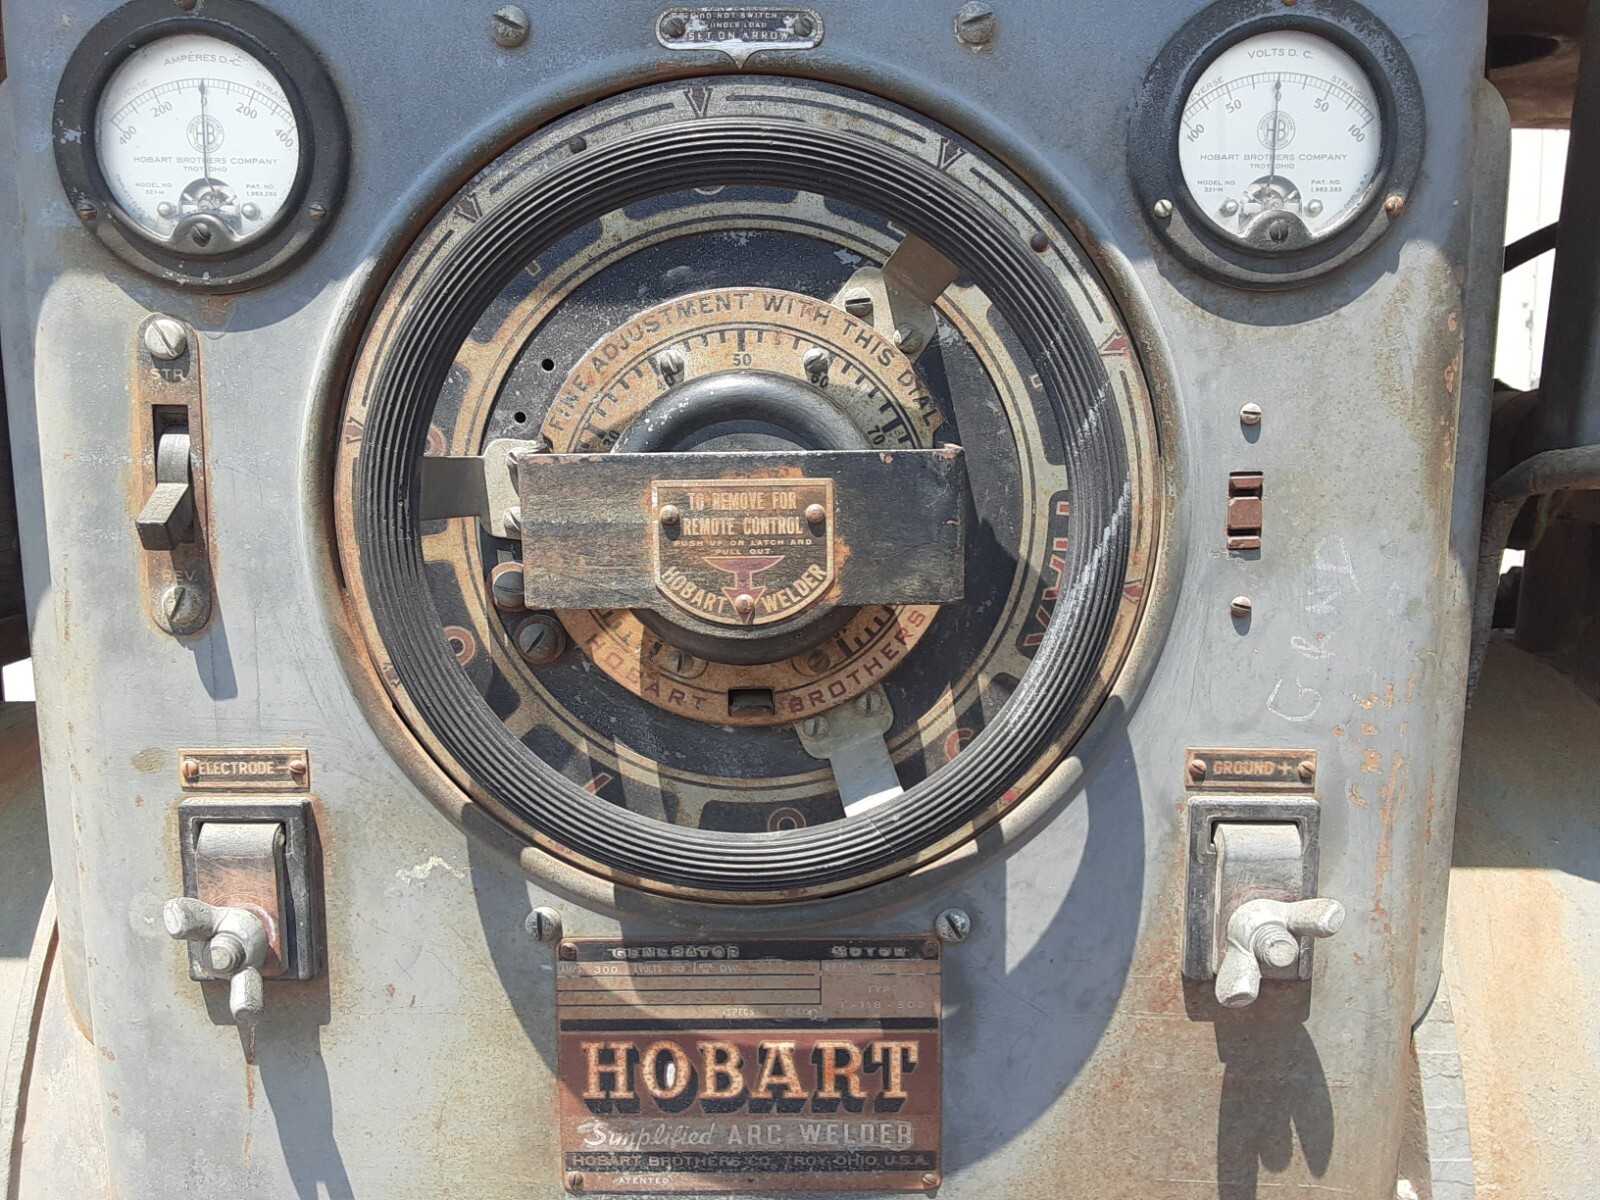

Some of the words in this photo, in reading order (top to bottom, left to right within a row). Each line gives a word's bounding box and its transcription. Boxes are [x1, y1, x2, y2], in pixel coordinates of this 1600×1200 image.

[687, 31, 712, 41] SET
[718, 31, 735, 40] ON
[743, 31, 790, 41] ARROW
[163, 53, 218, 66] AMPERES
[1247, 48, 1285, 60] VOLTS
[118, 125, 137, 146] 400
[150, 101, 173, 118] 200
[235, 102, 258, 120] 200
[274, 127, 294, 148] 400
[1186, 123, 1205, 143] 100
[1225, 98, 1242, 114] 50
[1313, 98, 1330, 113] 50
[1347, 123, 1366, 143] 100
[133, 156, 173, 164] HOBART
[176, 156, 227, 165] BROTHERS
[230, 157, 278, 165] COMPANY
[1200, 153, 1240, 161] HOBART
[1243, 153, 1295, 161] BROTHERS
[1298, 153, 1348, 161] COMPANY
[591, 292, 748, 371] ADJUSTMENT
[761, 292, 832, 328] WITH
[844, 317, 902, 368] THIS
[897, 369, 938, 426] DIAL
[733, 353, 752, 367] 50
[867, 425, 886, 445] 70
[687, 492, 705, 511] TO
[712, 492, 765, 511] REMOVE
[772, 491, 797, 510] FOR
[682, 517, 736, 536] REMOTE
[743, 516, 803, 535] CONTROL
[790, 538, 812, 546] AND
[661, 565, 729, 614] HOBART
[761, 563, 828, 613] WELDER
[584, 633, 712, 711] HOBART
[787, 610, 926, 714] BROTHERS
[198, 761, 274, 775] ELECTRODE
[1213, 760, 1276, 776] GROUND
[611, 946, 740, 959] GENERATOR
[593, 965, 618, 974] 300
[580, 1040, 920, 1103] HOBART
[580, 1120, 715, 1150] Simplified
[727, 1122, 782, 1145] ARC
[800, 1122, 913, 1145] WELDER
[572, 1154, 641, 1167] HOBART
[649, 1154, 741, 1167] BROTHERS
